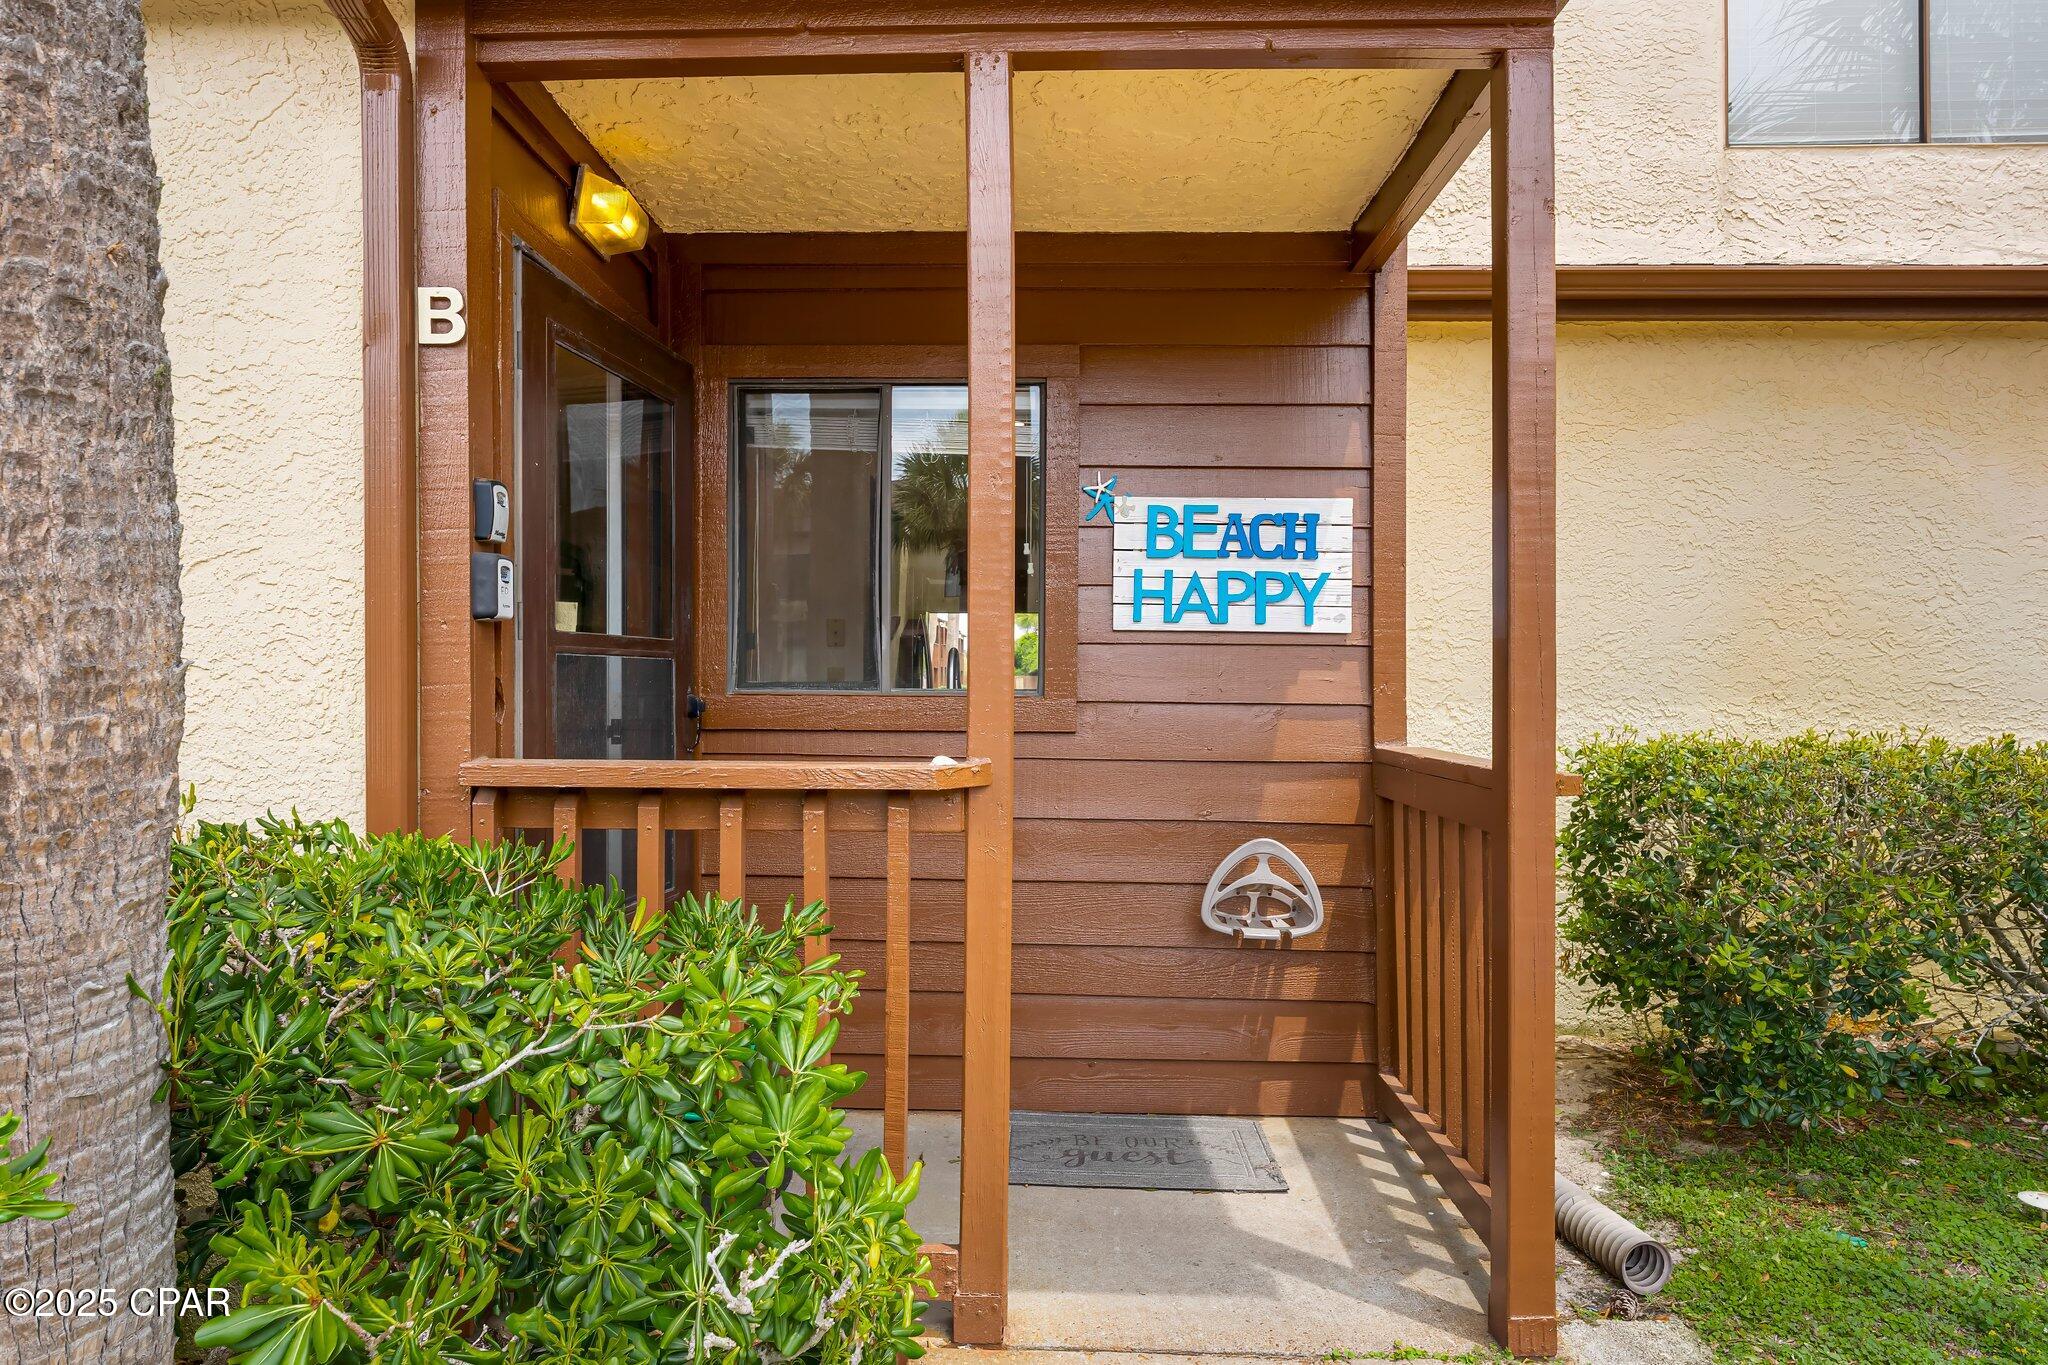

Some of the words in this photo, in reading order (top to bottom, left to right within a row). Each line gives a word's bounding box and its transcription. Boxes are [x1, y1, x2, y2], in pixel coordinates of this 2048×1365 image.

[418, 287, 466, 345] B
[1146, 504, 1320, 560] BEACH
[1132, 568, 1331, 626] HAPPY
[1062, 1148, 1191, 1168] guest
[1124, 1135, 1183, 1149] OUR
